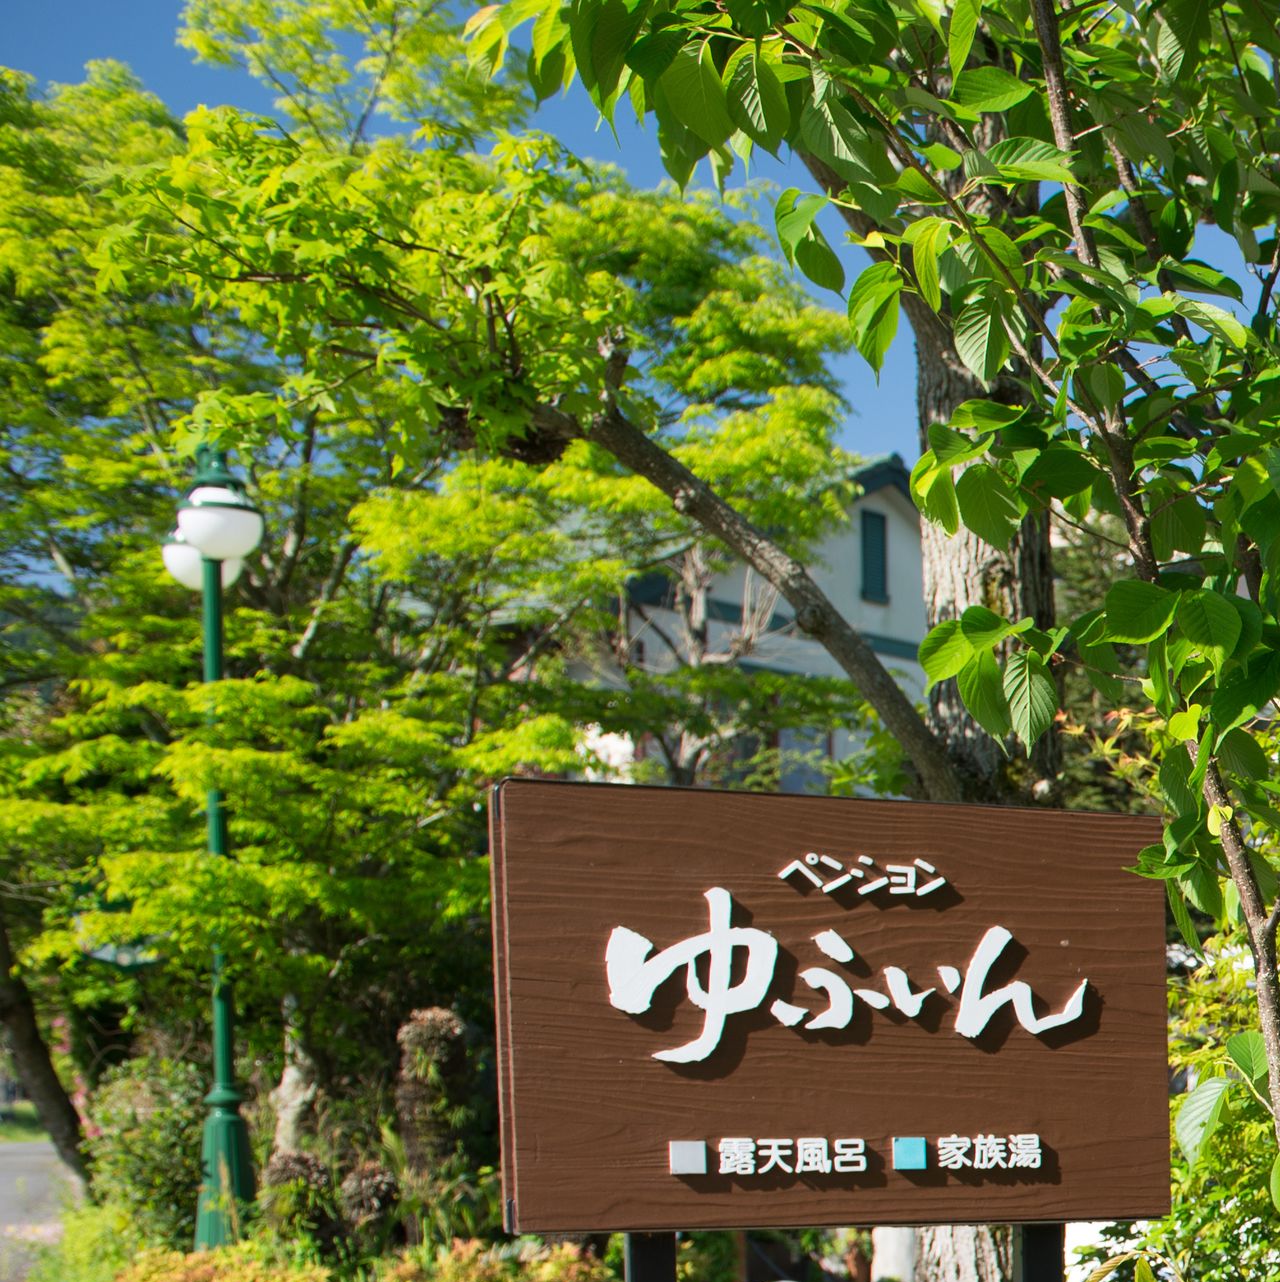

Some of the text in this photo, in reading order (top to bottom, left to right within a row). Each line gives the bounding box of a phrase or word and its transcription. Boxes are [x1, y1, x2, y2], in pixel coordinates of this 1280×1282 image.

[777, 852, 946, 896] ペンション
[605, 886, 1088, 1064] ゆふいん
[718, 1132, 1042, 1175] 露天風呂 家族湯
